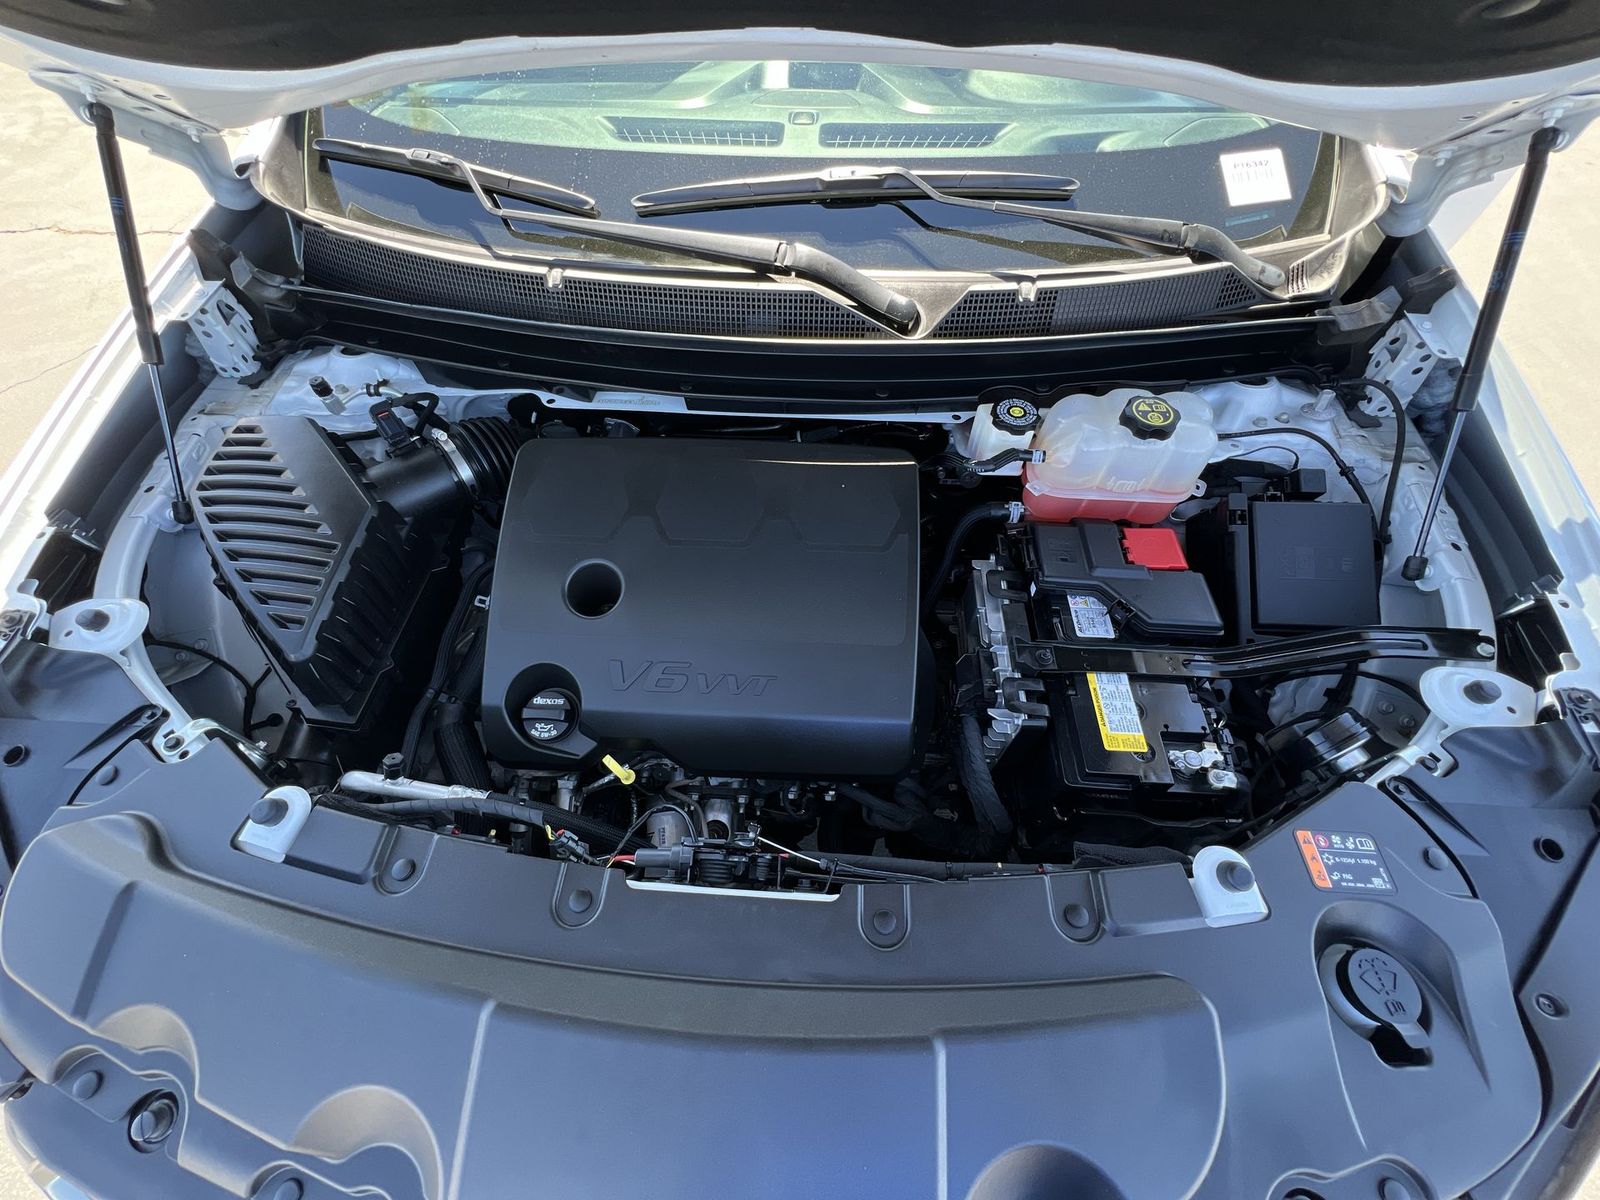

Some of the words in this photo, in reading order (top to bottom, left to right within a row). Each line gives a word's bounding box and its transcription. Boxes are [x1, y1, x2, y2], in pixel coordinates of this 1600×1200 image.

[608, 659, 692, 693] V6
[696, 672, 778, 697] VVT
[533, 696, 566, 705] dexos
